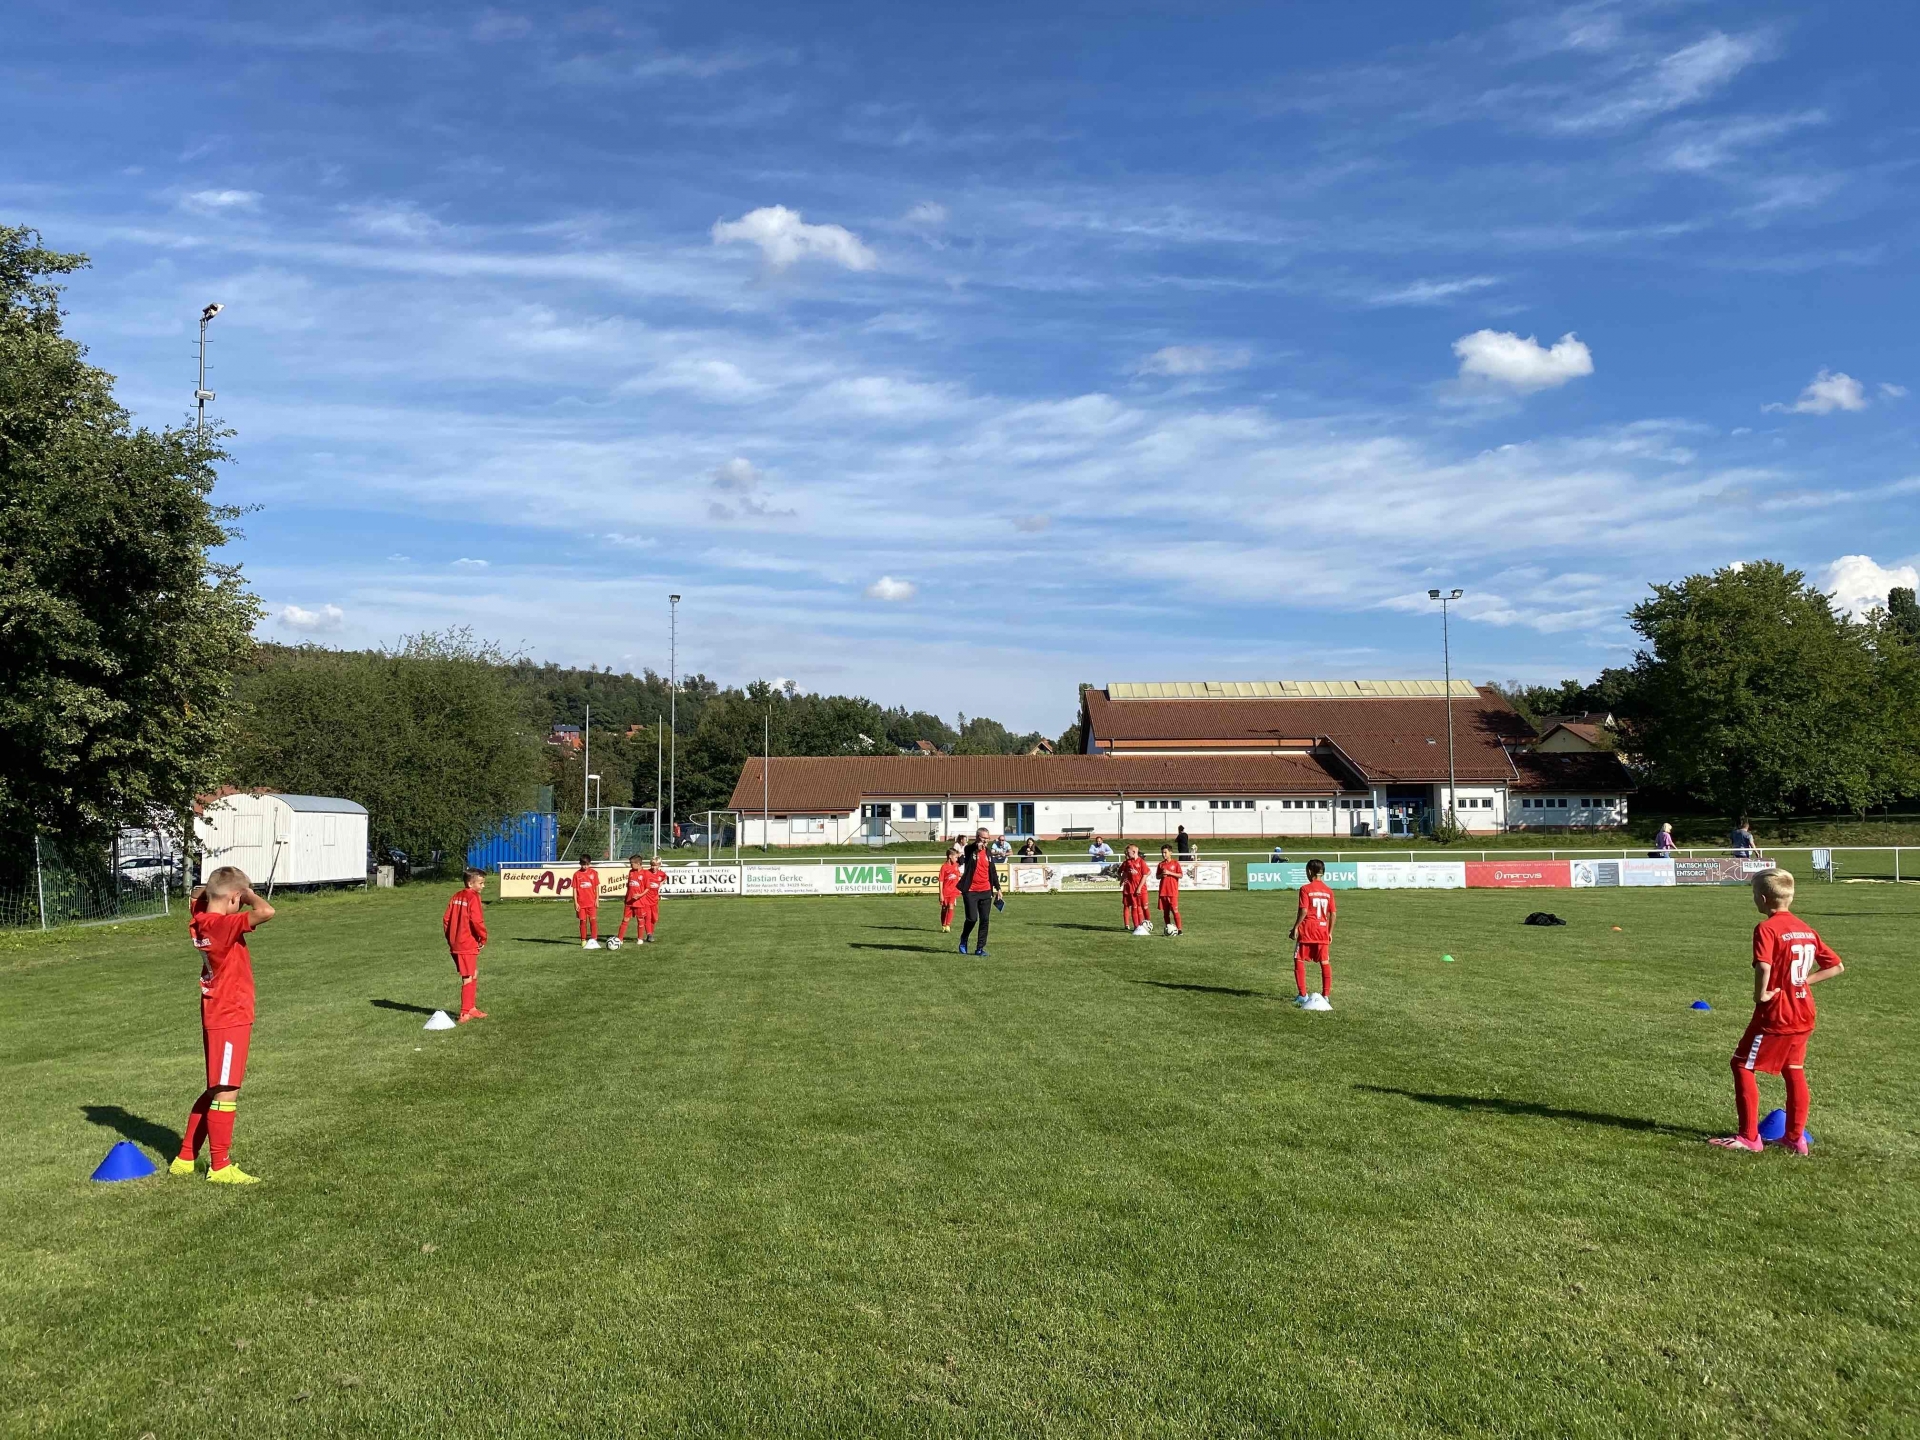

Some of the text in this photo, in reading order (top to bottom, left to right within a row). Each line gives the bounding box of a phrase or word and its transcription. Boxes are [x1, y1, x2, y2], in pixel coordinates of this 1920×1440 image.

[503, 872, 541, 880] Bäckerei
[747, 874, 803, 882] Bastian Gerke
[835, 866, 873, 884] LVM
[897, 873, 939, 886] Krege
[1249, 872, 1281, 882] DEVK
[1324, 872, 1356, 881] DEVK
[533, 871, 572, 895] Ap
[1791, 943, 1816, 986] 20
